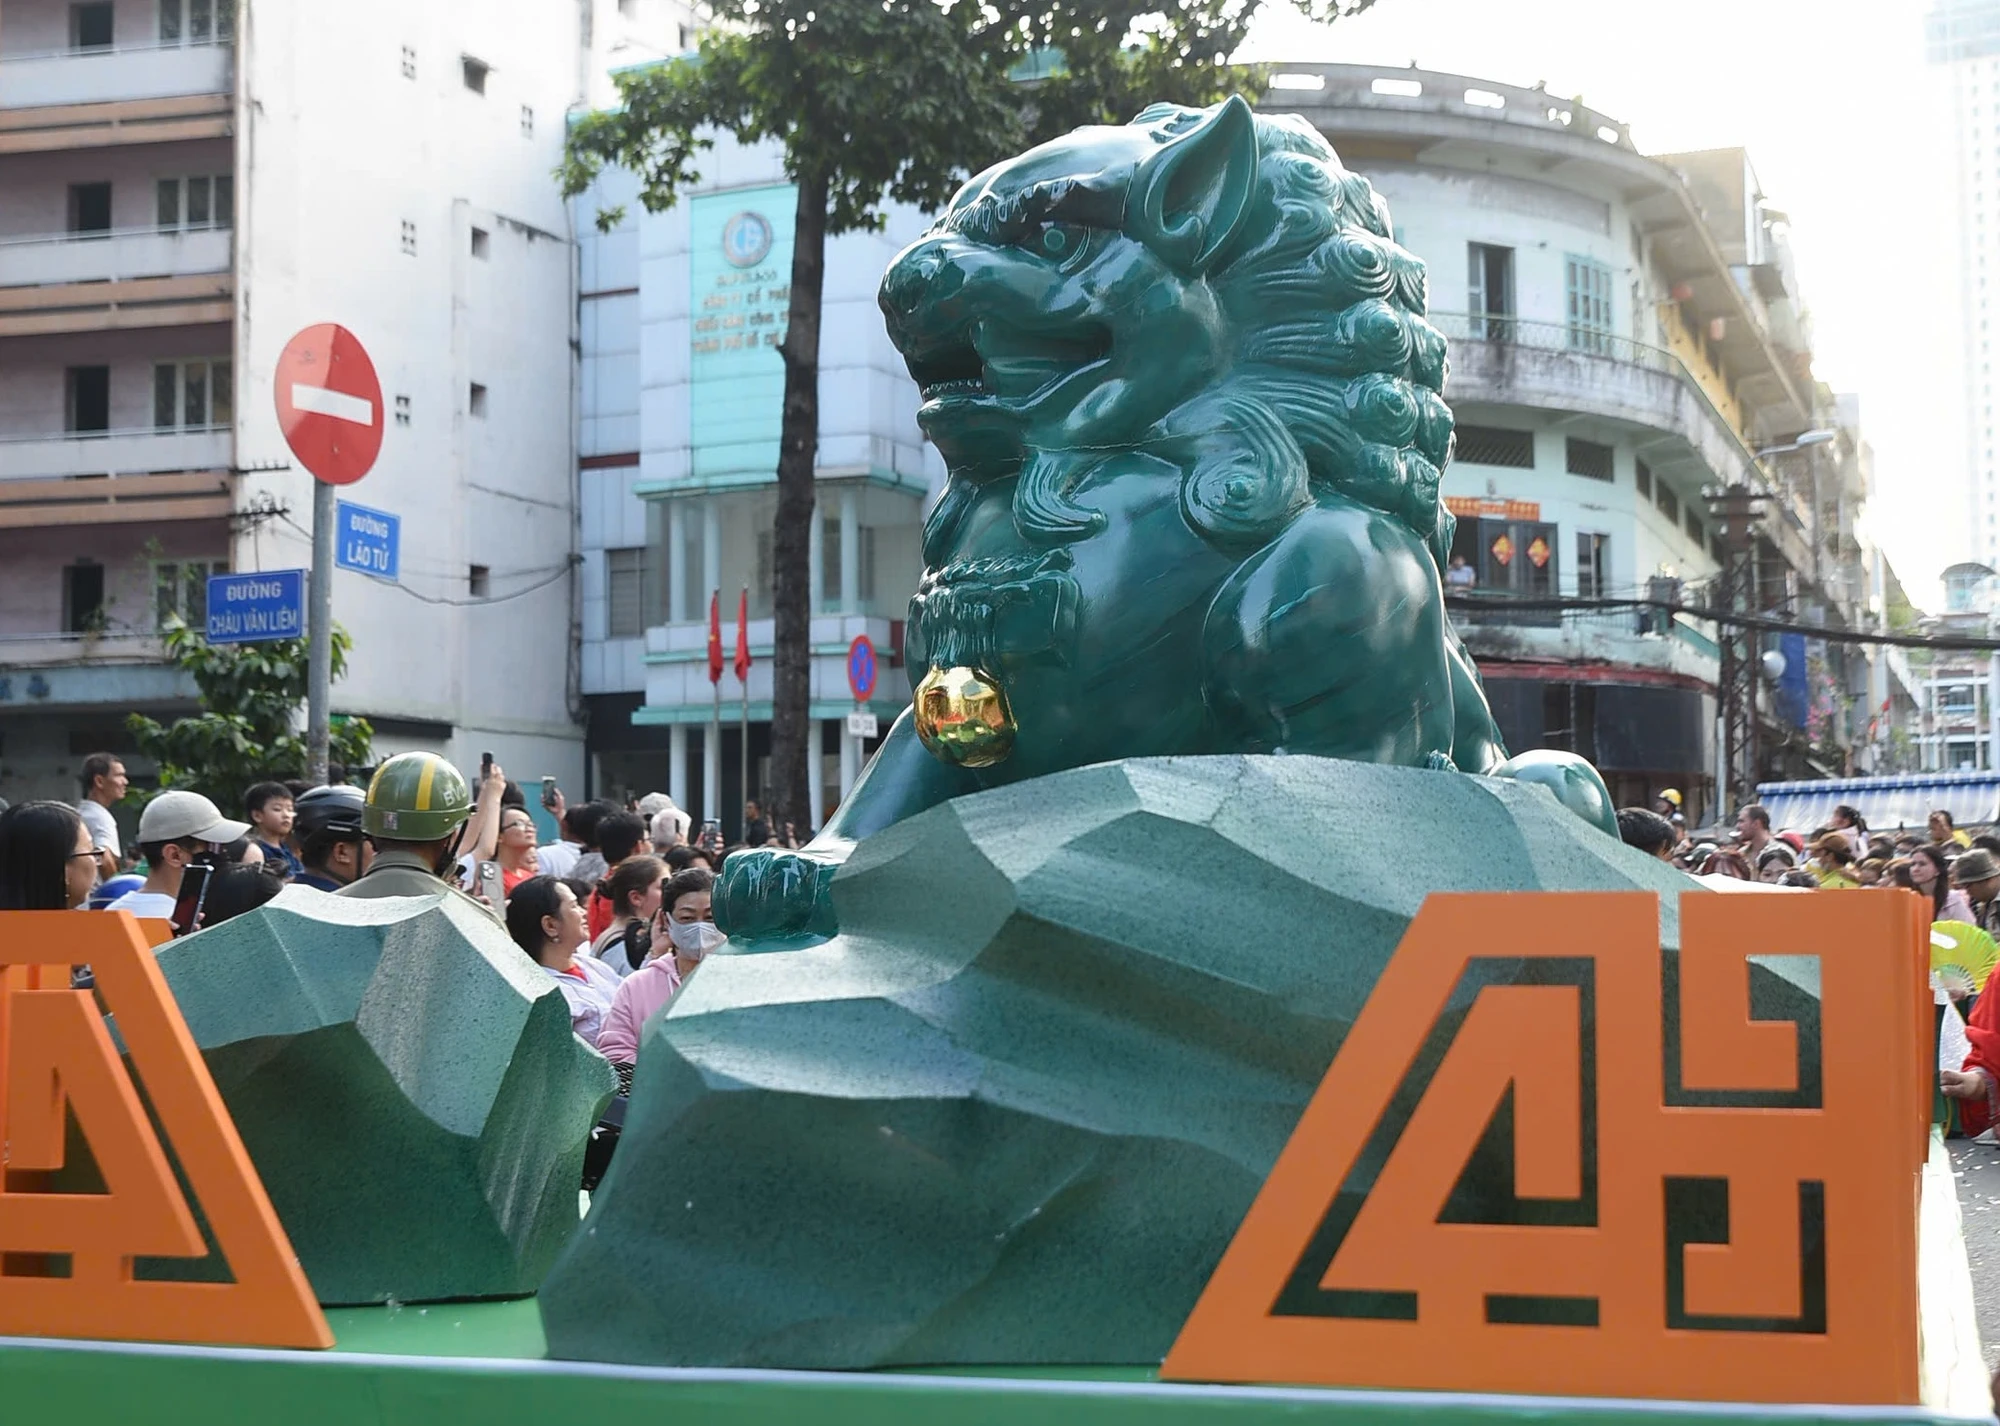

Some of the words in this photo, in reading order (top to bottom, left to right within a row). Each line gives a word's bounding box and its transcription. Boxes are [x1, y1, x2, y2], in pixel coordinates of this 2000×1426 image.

[351, 513, 389, 540] ĐƯỜNG
[347, 541, 370, 566] LÃO
[373, 542, 390, 571] TỬ
[226, 580, 282, 601] ĐƯỜNG
[209, 610, 240, 636] CHÂU
[243, 608, 266, 632] VĂN
[269, 605, 298, 631] LIÊM
